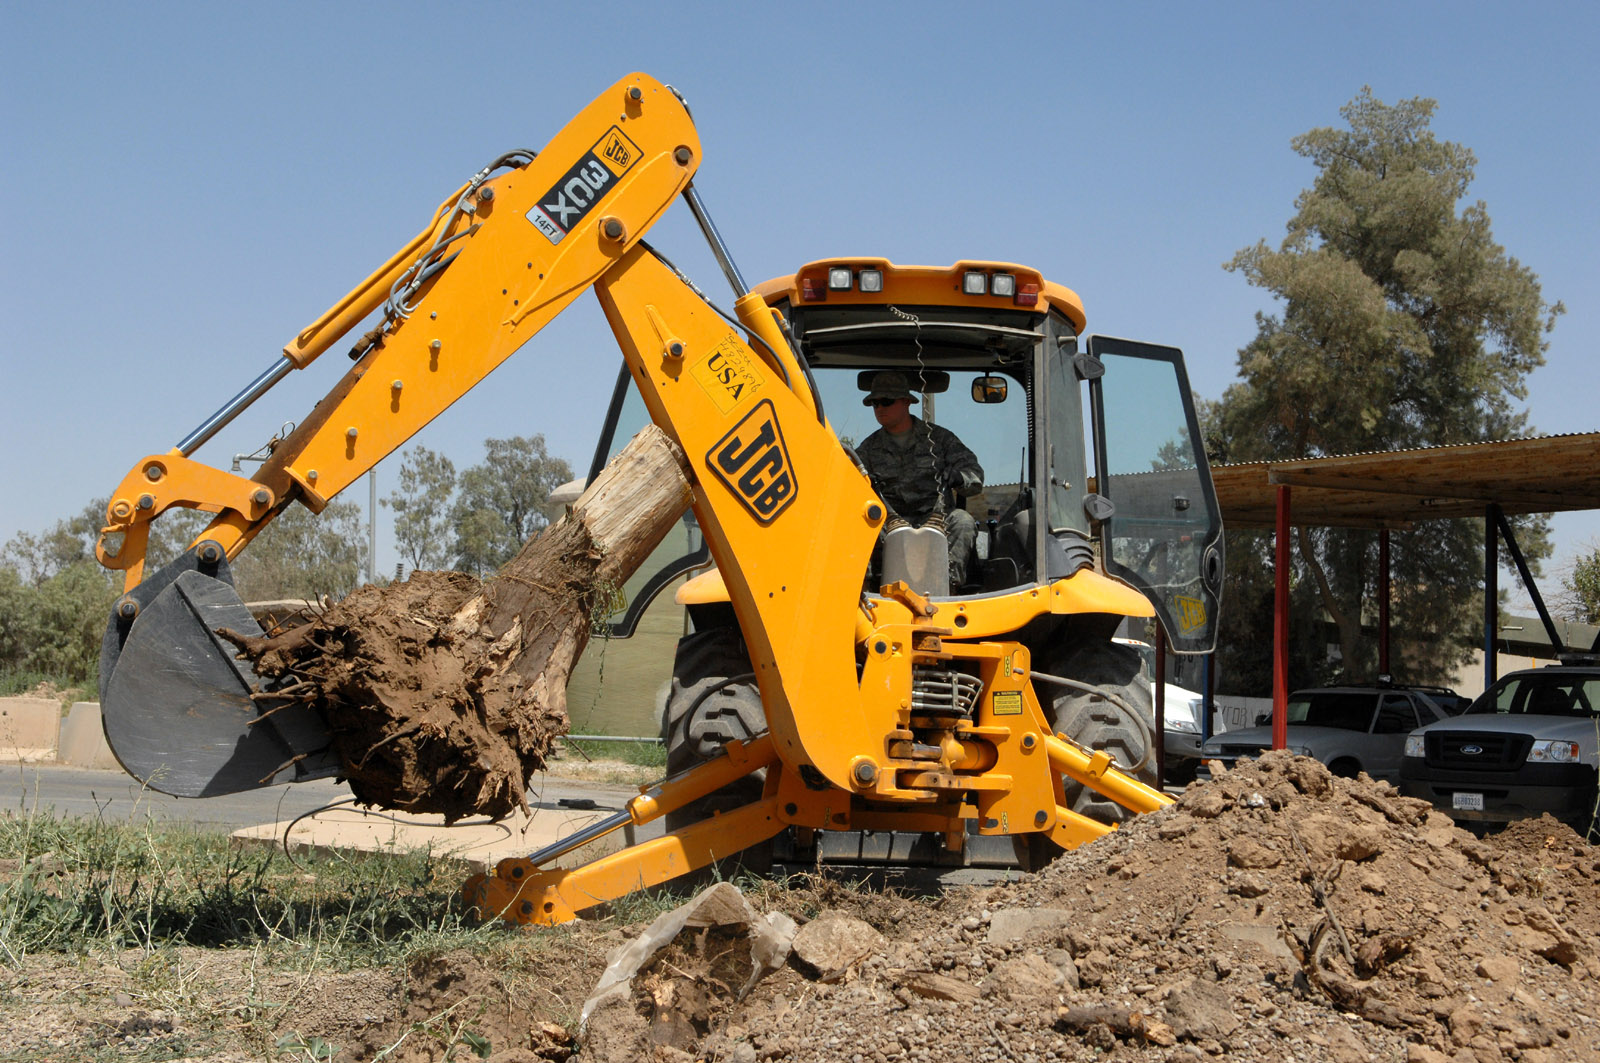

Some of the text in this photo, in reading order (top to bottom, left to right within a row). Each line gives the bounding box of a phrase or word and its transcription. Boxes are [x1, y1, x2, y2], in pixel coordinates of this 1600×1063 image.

[605, 138, 629, 165] JCB
[544, 160, 610, 229] 3CX
[534, 214, 558, 237] 14FT
[707, 350, 745, 401] USA
[717, 419, 792, 514] JCB
[1180, 599, 1206, 630] JCB
